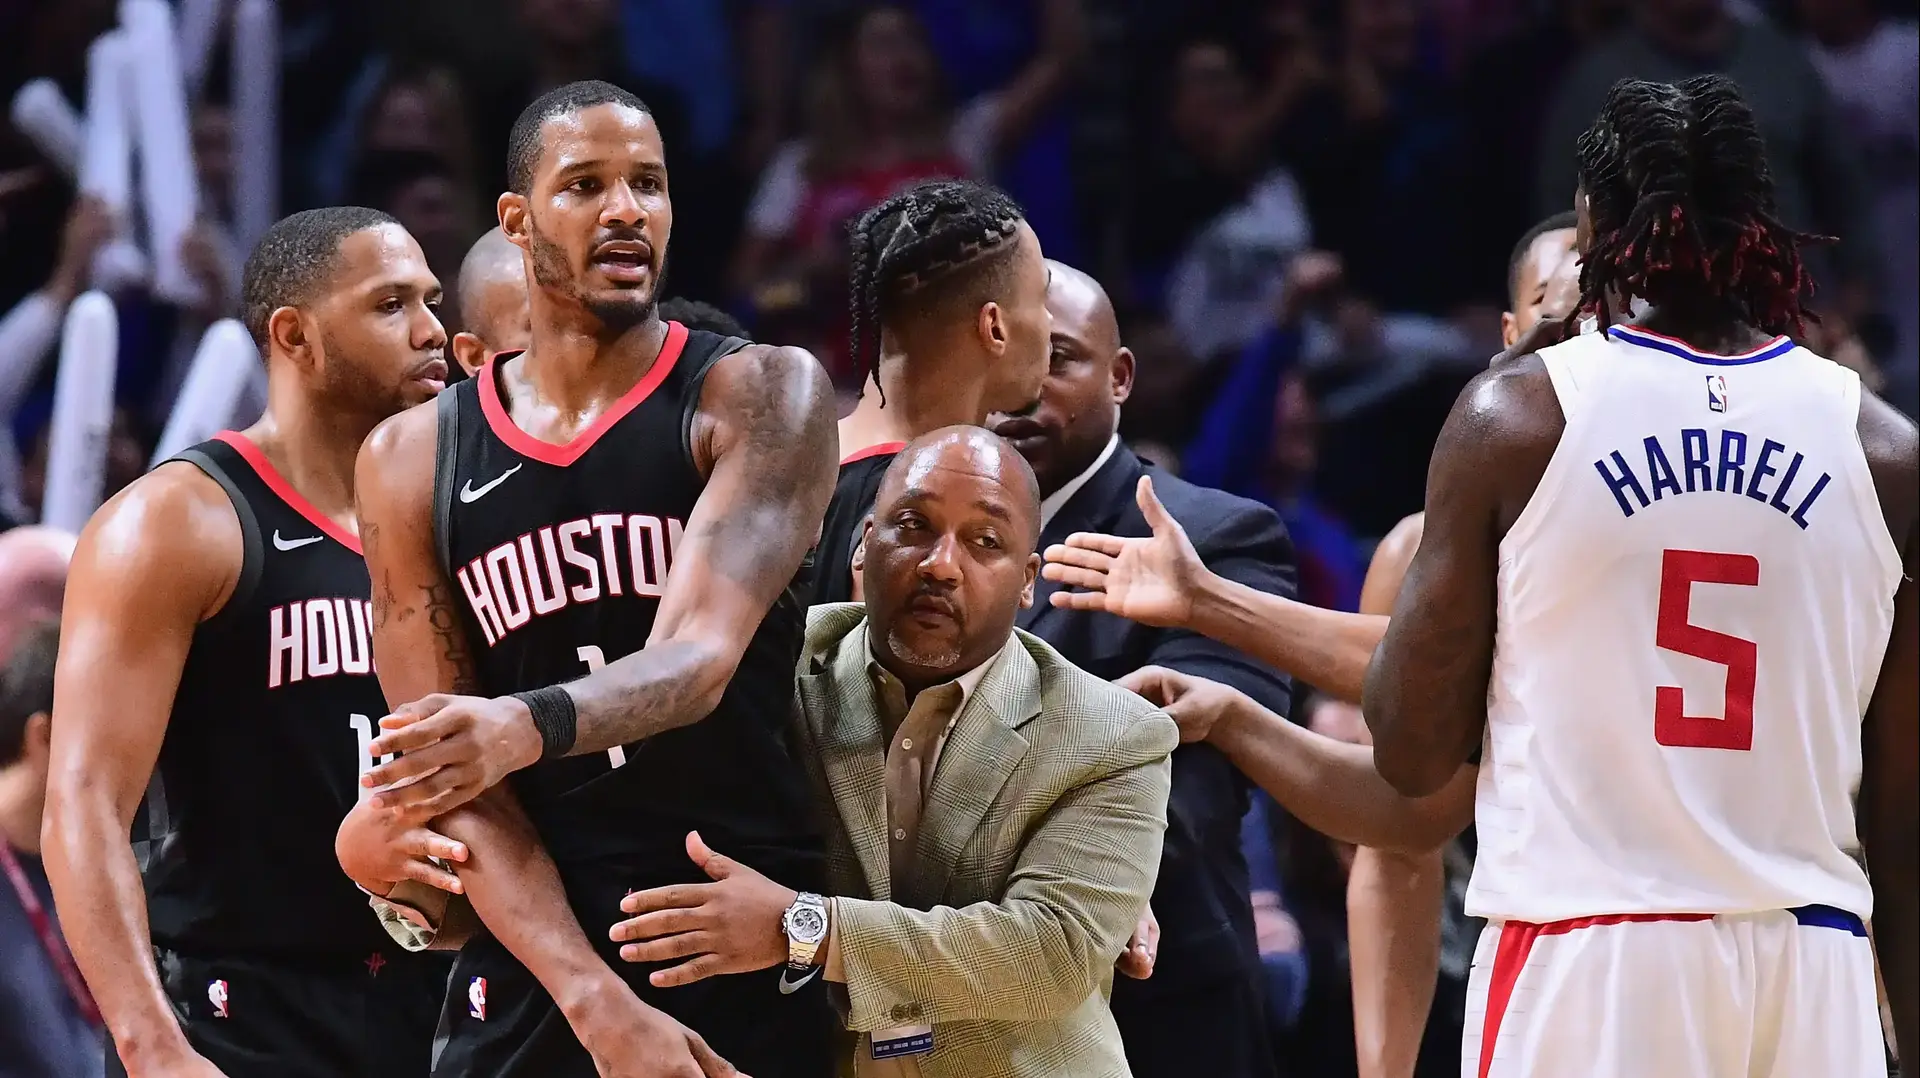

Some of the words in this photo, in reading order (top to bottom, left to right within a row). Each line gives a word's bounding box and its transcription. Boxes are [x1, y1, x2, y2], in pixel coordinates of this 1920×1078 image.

[1593, 428, 1832, 531] HARRELL
[268, 597, 377, 688] HOU
[1654, 548, 1760, 751] 5
